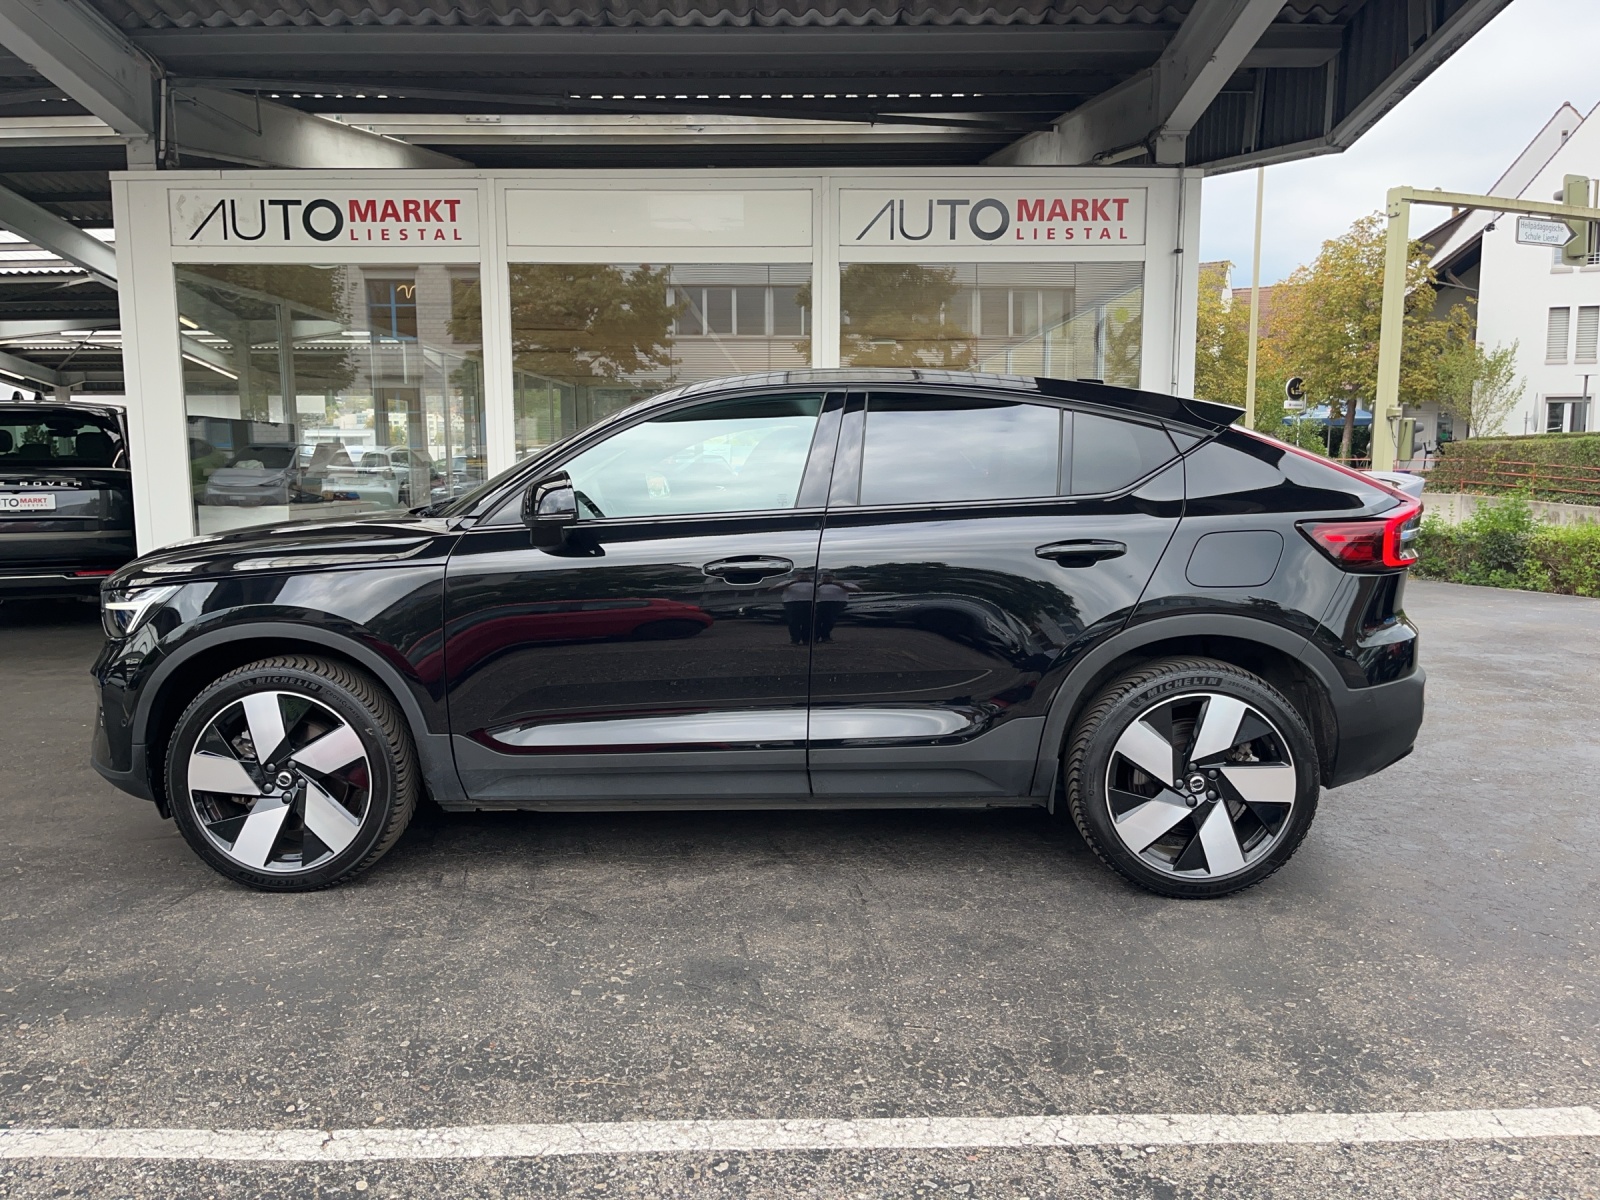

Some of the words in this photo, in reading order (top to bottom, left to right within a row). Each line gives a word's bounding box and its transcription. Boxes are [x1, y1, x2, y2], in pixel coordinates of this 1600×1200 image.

[189, 199, 344, 242] AUTO
[348, 199, 461, 223] MARKT
[855, 198, 1010, 241] AUTO
[1016, 198, 1129, 222] MARKT
[349, 228, 462, 241] LIESTAL
[1016, 227, 1128, 240] LIESTAL
[1524, 231, 1541, 241] Schule
[1542, 233, 1559, 242] Liestal
[0, 498, 19, 507] TO
[256, 676, 319, 690] MICHELIN
[1147, 677, 1218, 698] MICHELIN
